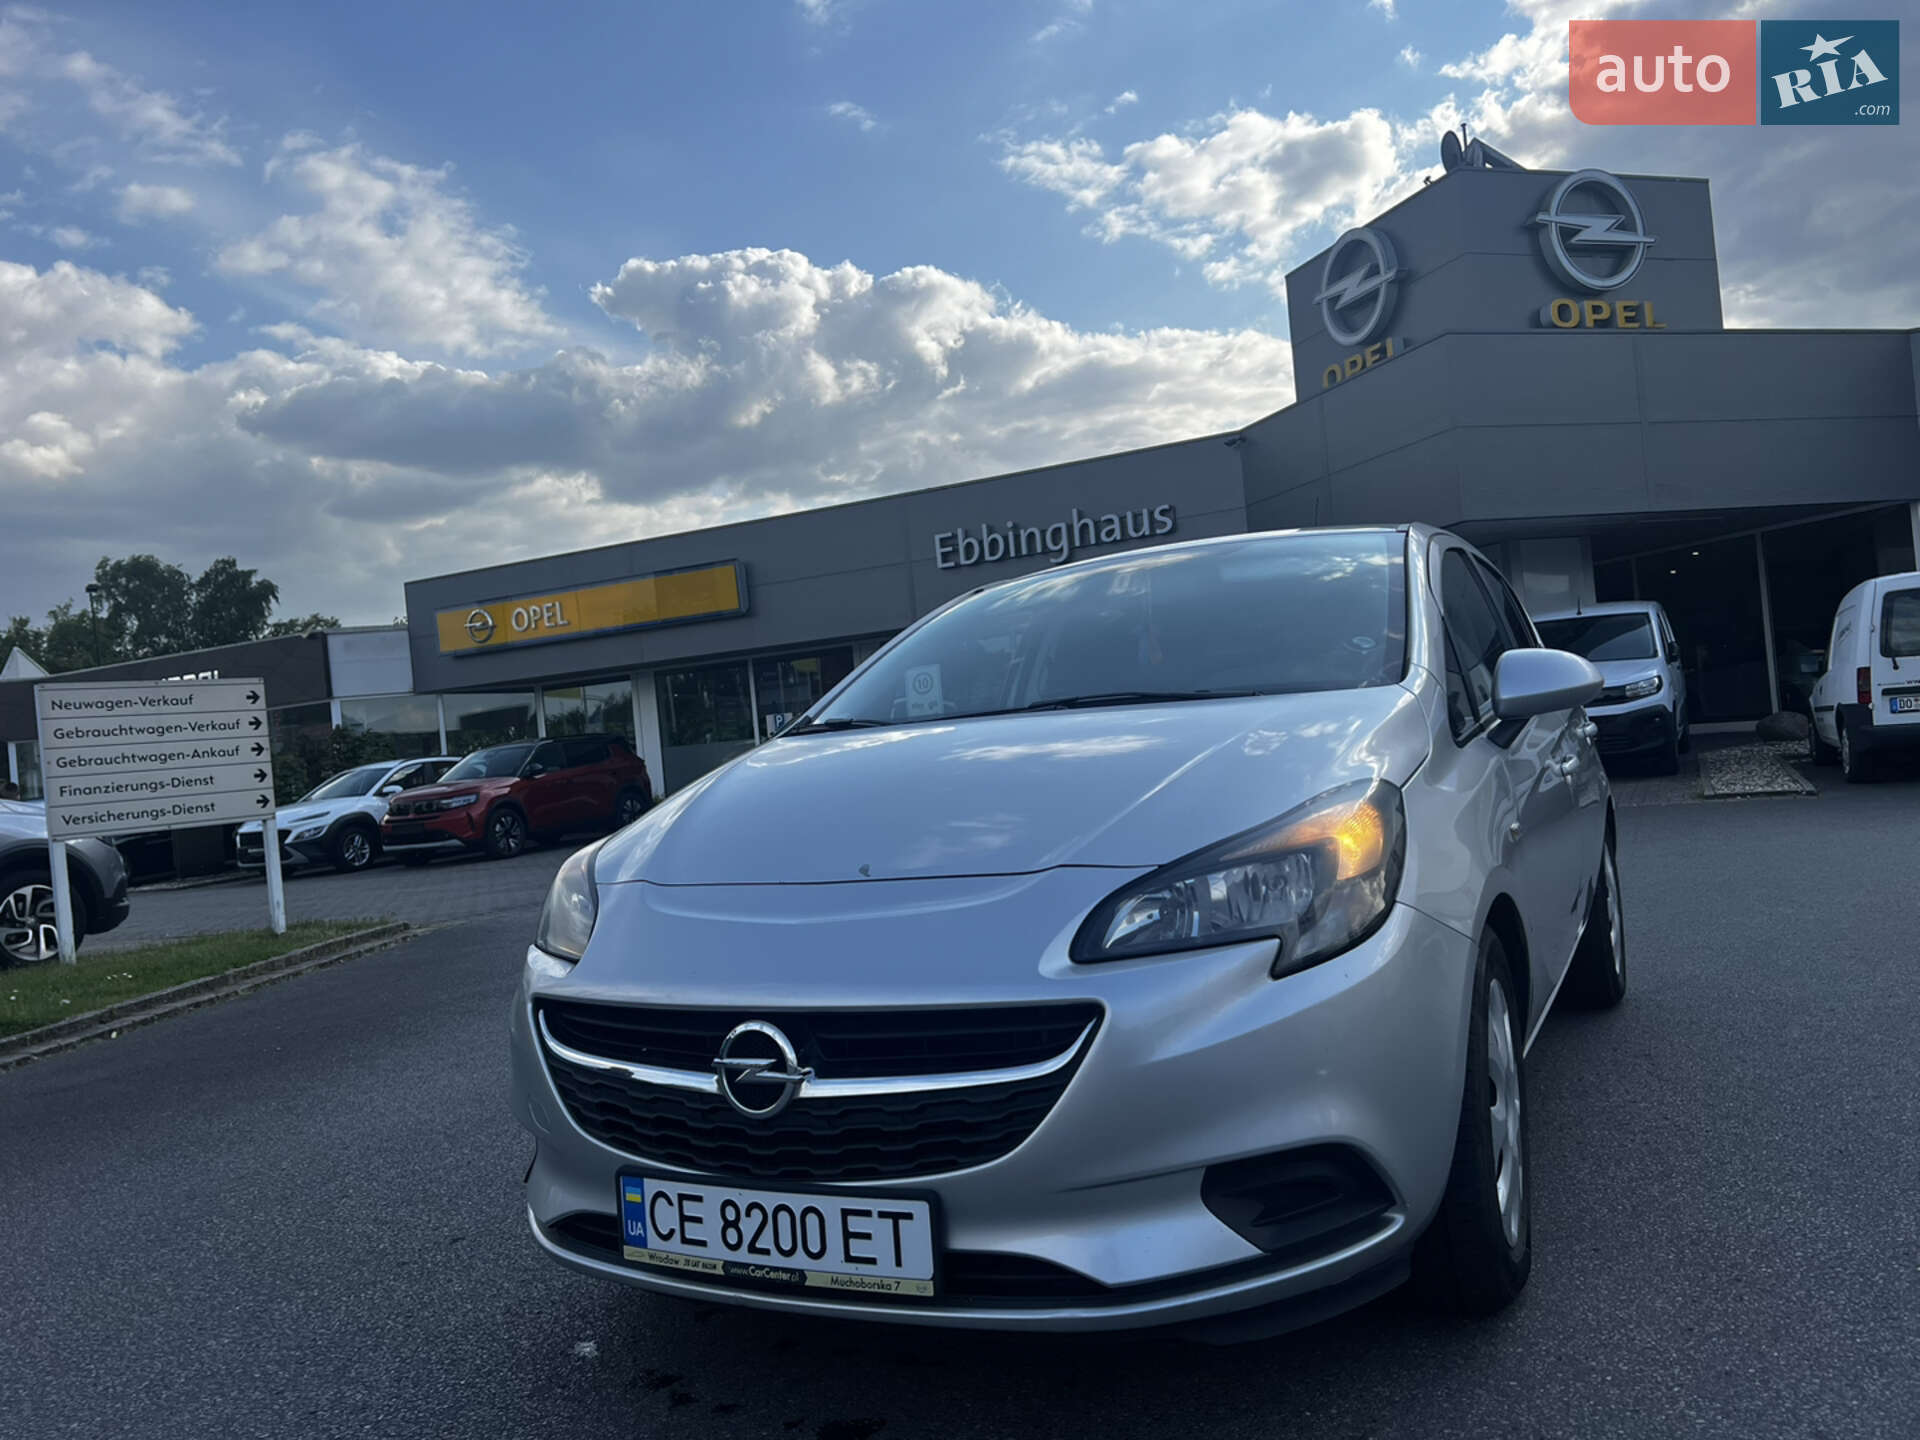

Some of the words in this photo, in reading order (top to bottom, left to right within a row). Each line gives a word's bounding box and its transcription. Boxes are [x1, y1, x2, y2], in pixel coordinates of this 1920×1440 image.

[1552, 298, 1667, 328] OPEL
[934, 504, 1175, 569] Ebbinghaus
[512, 601, 569, 632] OPEL
[51, 694, 194, 712] Neuwagen-Verkauf
[53, 719, 241, 740] Gebrauchtwagen-Verkauf
[56, 745, 241, 769] Gebrauchtwagen-Ankauf
[59, 775, 215, 797] Finanzierungs-Dienst
[62, 802, 216, 826] Versicherungs-Dienst
[628, 1219, 645, 1237] UA
[650, 1190, 708, 1248] CE
[720, 1198, 827, 1260] 8200
[840, 1207, 914, 1268] ET
